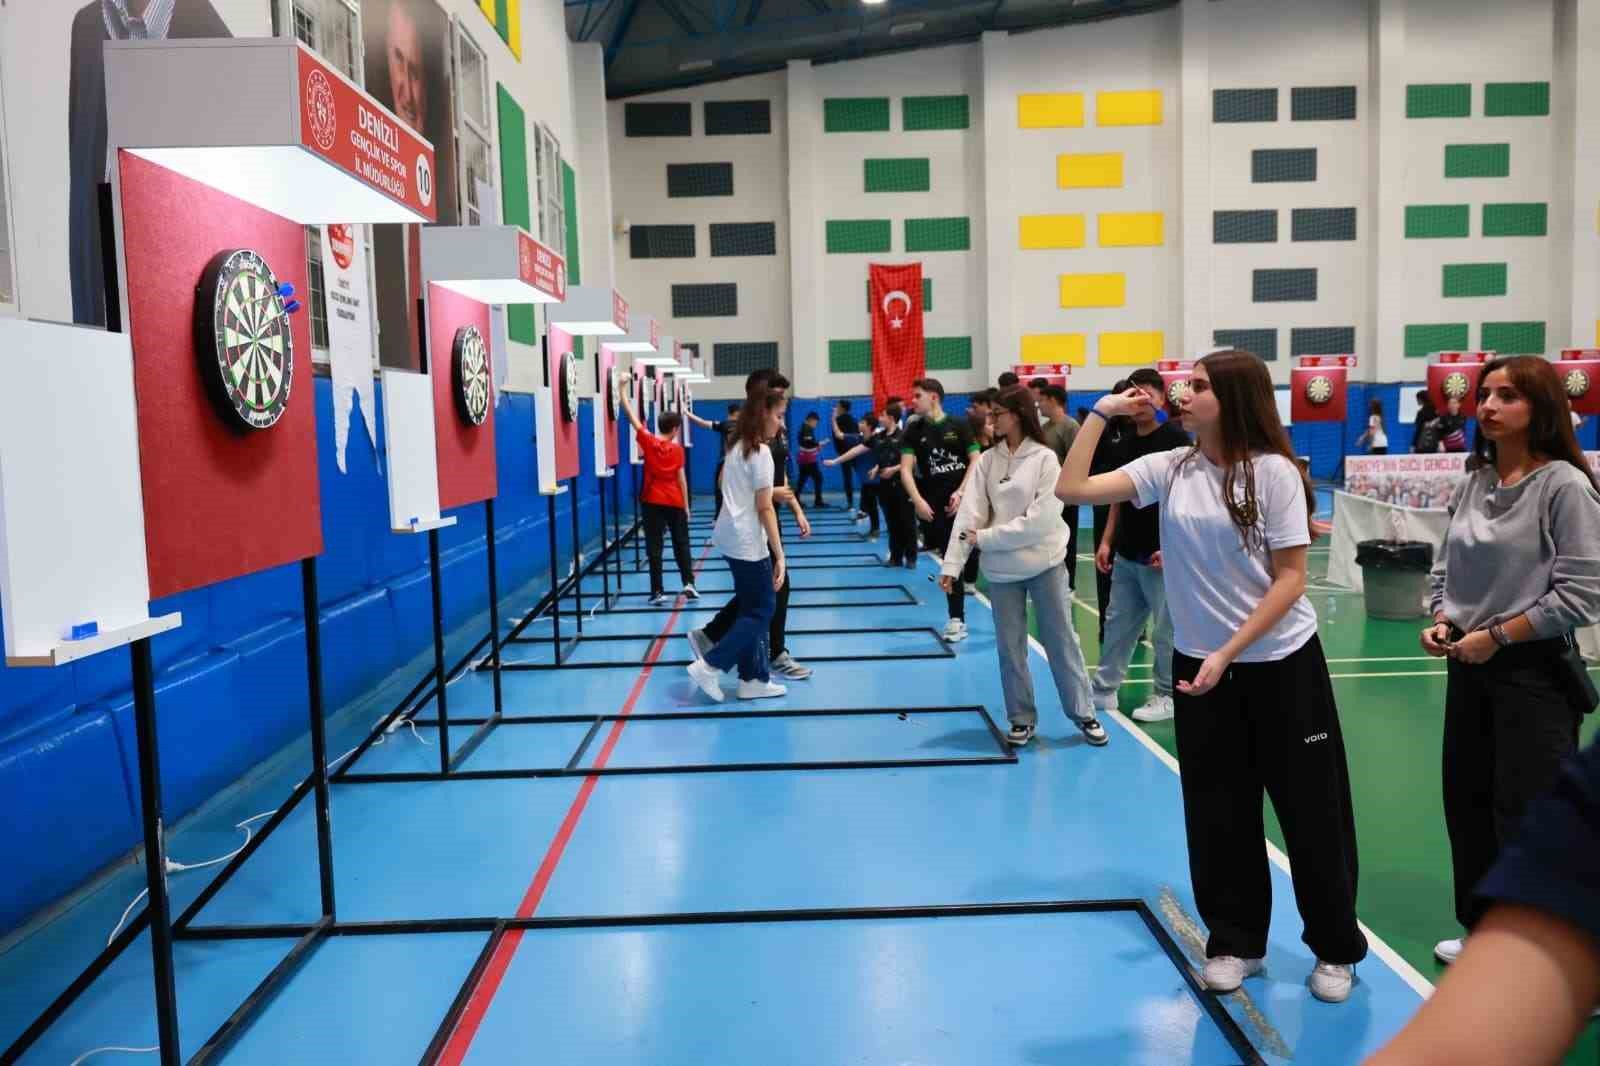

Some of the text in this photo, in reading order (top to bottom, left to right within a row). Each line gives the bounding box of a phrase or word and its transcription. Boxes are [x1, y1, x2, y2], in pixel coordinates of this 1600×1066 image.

[358, 103, 399, 152] DENİZLİ
[351, 130, 407, 178] GENÇLİK VE SPOR
[355, 152, 405, 199] İL MÜDÜRLÜĞÜ
[418, 165, 430, 195] 10
[1304, 732, 1328, 744] VOID
